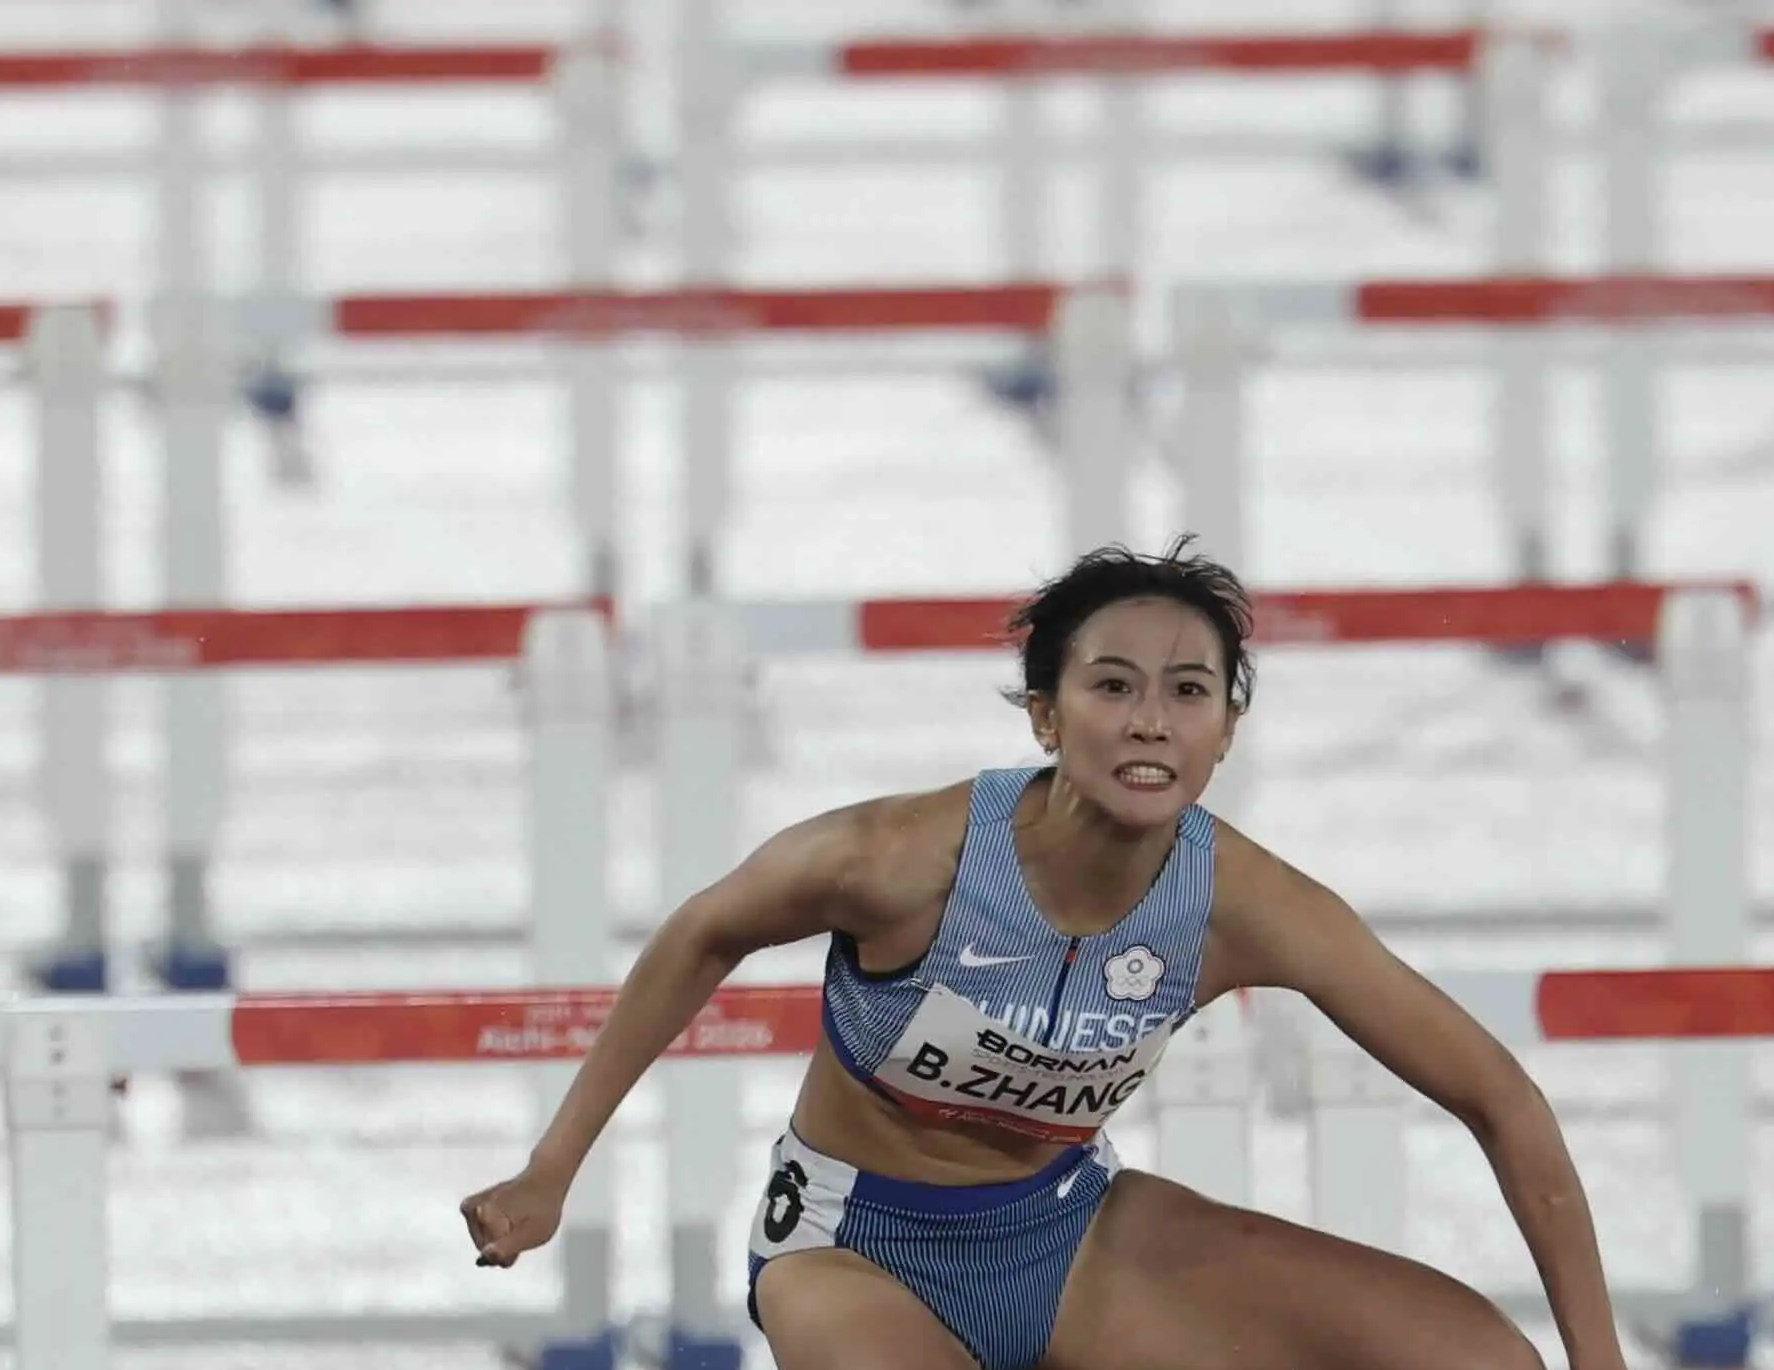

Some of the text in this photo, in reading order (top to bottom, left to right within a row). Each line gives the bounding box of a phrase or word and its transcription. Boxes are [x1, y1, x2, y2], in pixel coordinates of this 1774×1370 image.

[907, 1042, 1145, 1116] B.ZHANG
[977, 1029, 1138, 1073] BORNAN
[764, 1159, 809, 1243] 6
